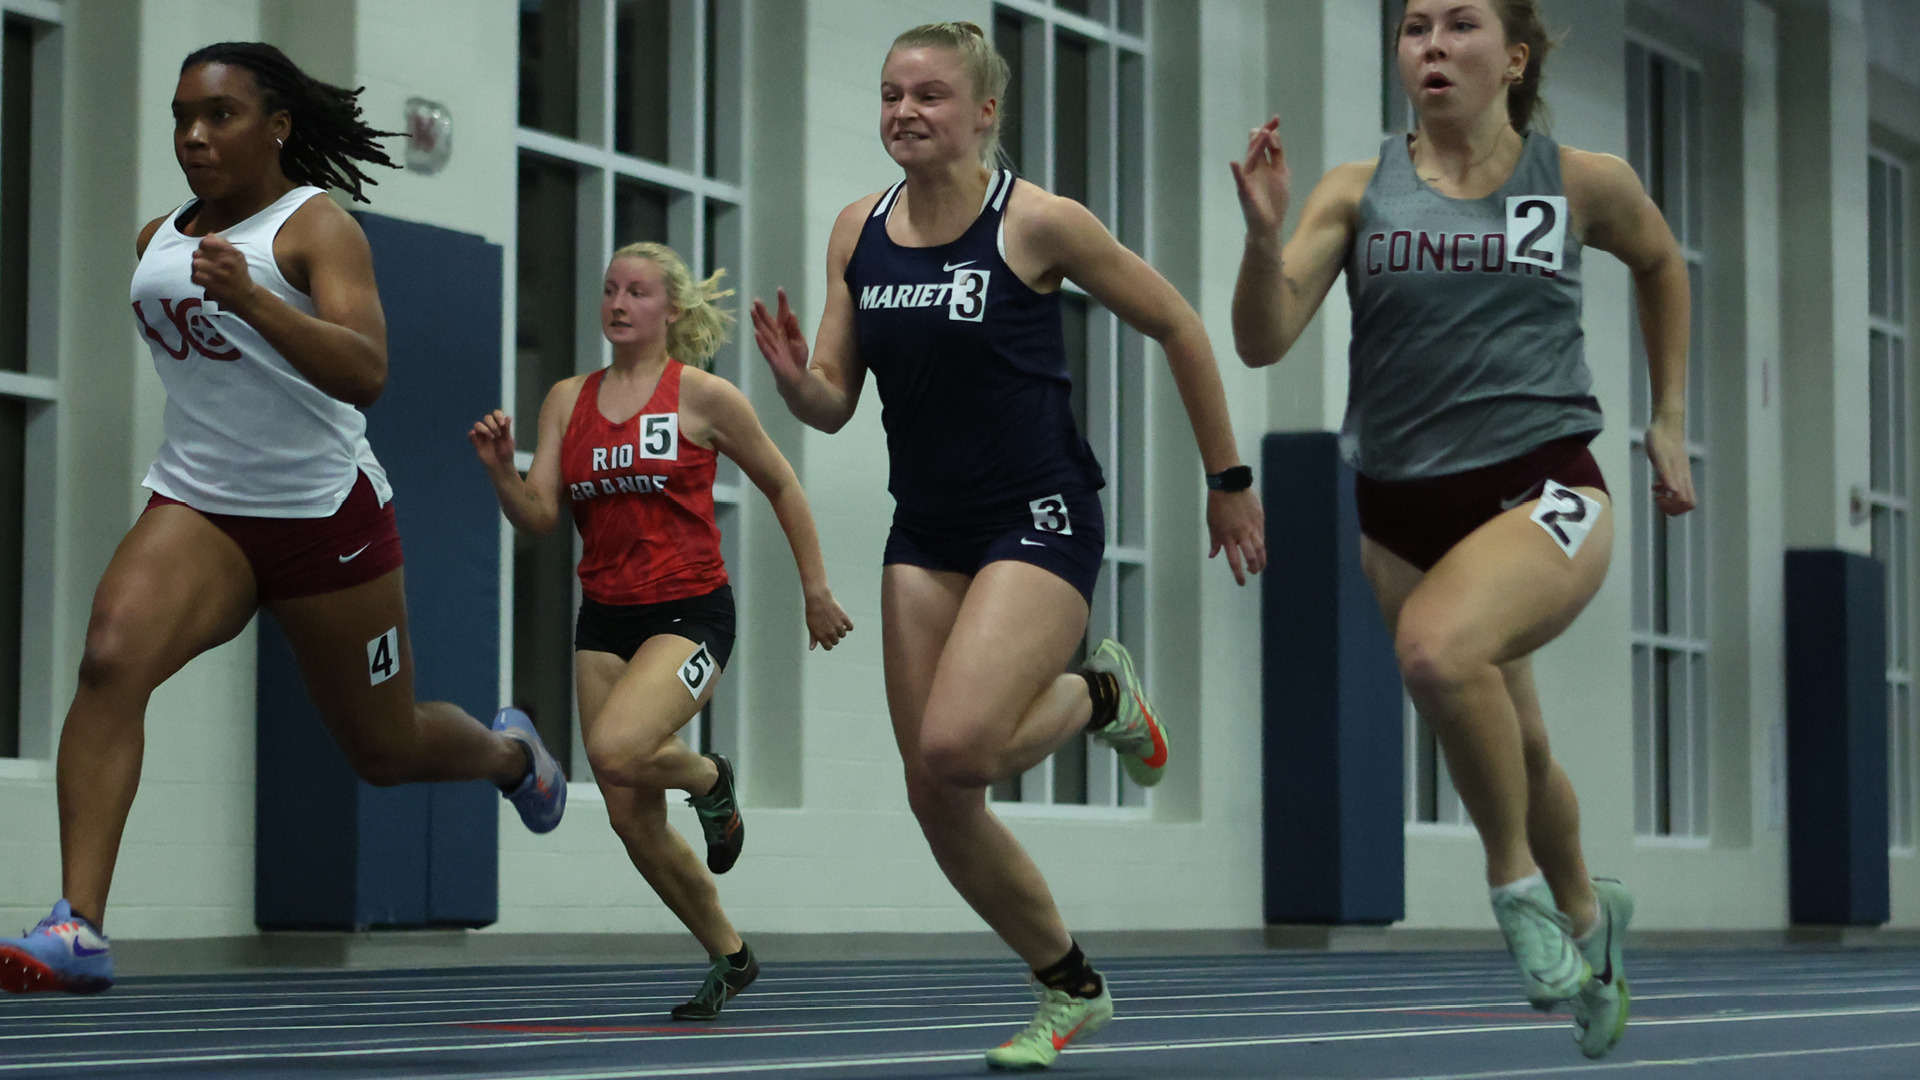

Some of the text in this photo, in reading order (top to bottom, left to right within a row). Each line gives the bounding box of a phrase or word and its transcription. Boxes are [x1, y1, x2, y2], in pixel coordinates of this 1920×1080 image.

[1514, 199, 1556, 263] 2
[1367, 230, 1556, 279] CONCO
[955, 272, 984, 319] 3
[592, 443, 634, 471] RIO
[645, 416, 671, 455] 5
[1038, 499, 1066, 532] 3
[1541, 489, 1586, 547] 2
[371, 634, 393, 678] 4
[683, 647, 711, 689] 5
